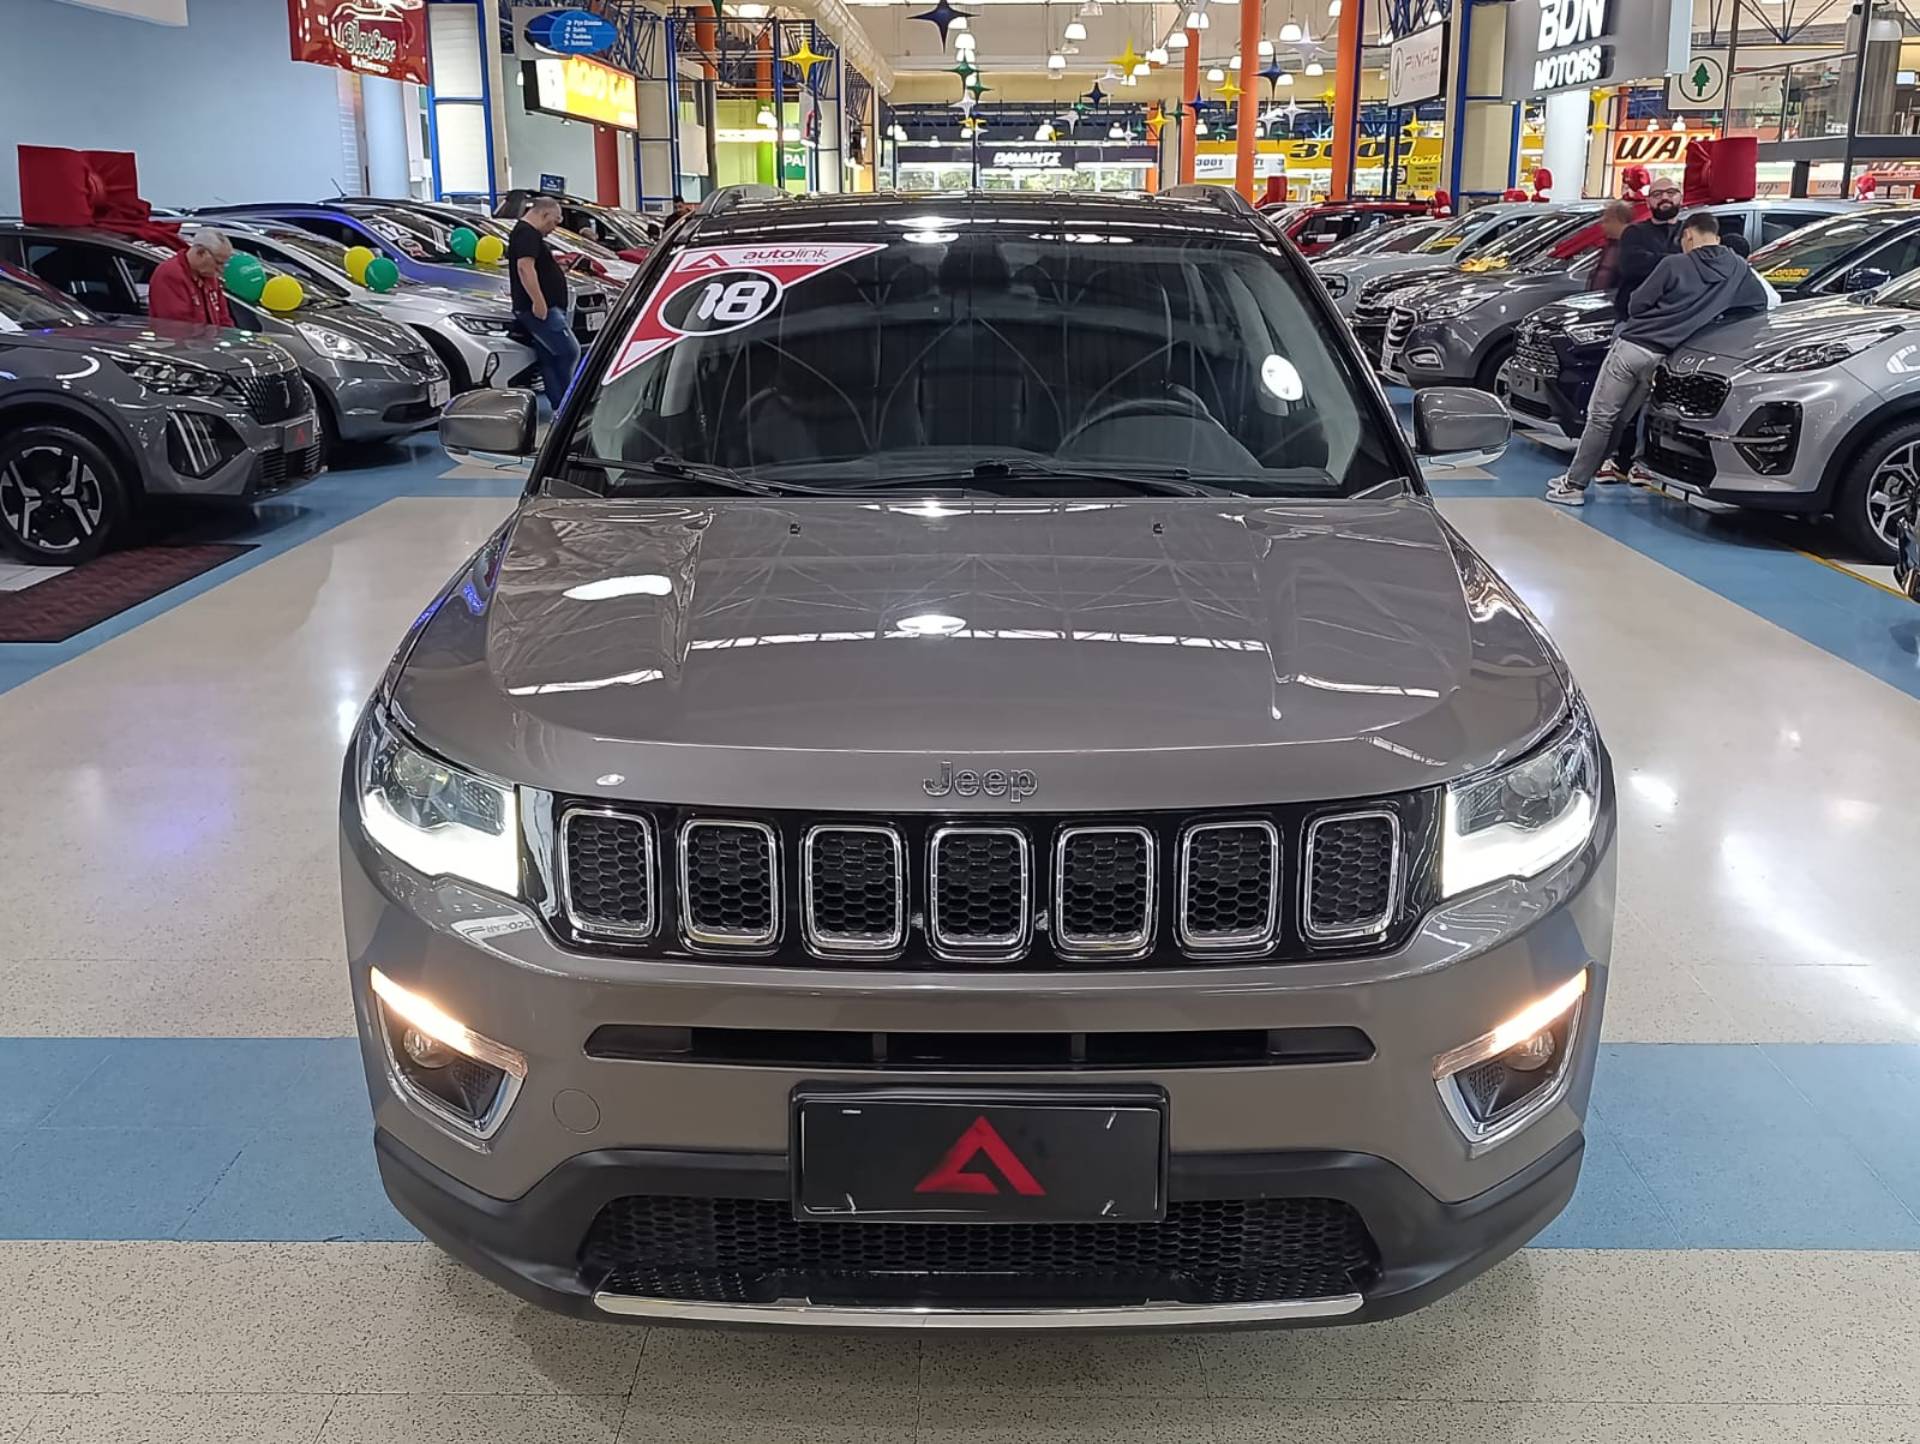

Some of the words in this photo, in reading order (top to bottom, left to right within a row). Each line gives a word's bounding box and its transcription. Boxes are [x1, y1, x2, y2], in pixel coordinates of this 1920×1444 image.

[1538, 0, 1606, 52] BDN
[1533, 44, 1602, 91] MOTORS
[743, 248, 828, 260] autolink
[697, 281, 769, 321] 18
[923, 760, 1038, 803] Jeep
